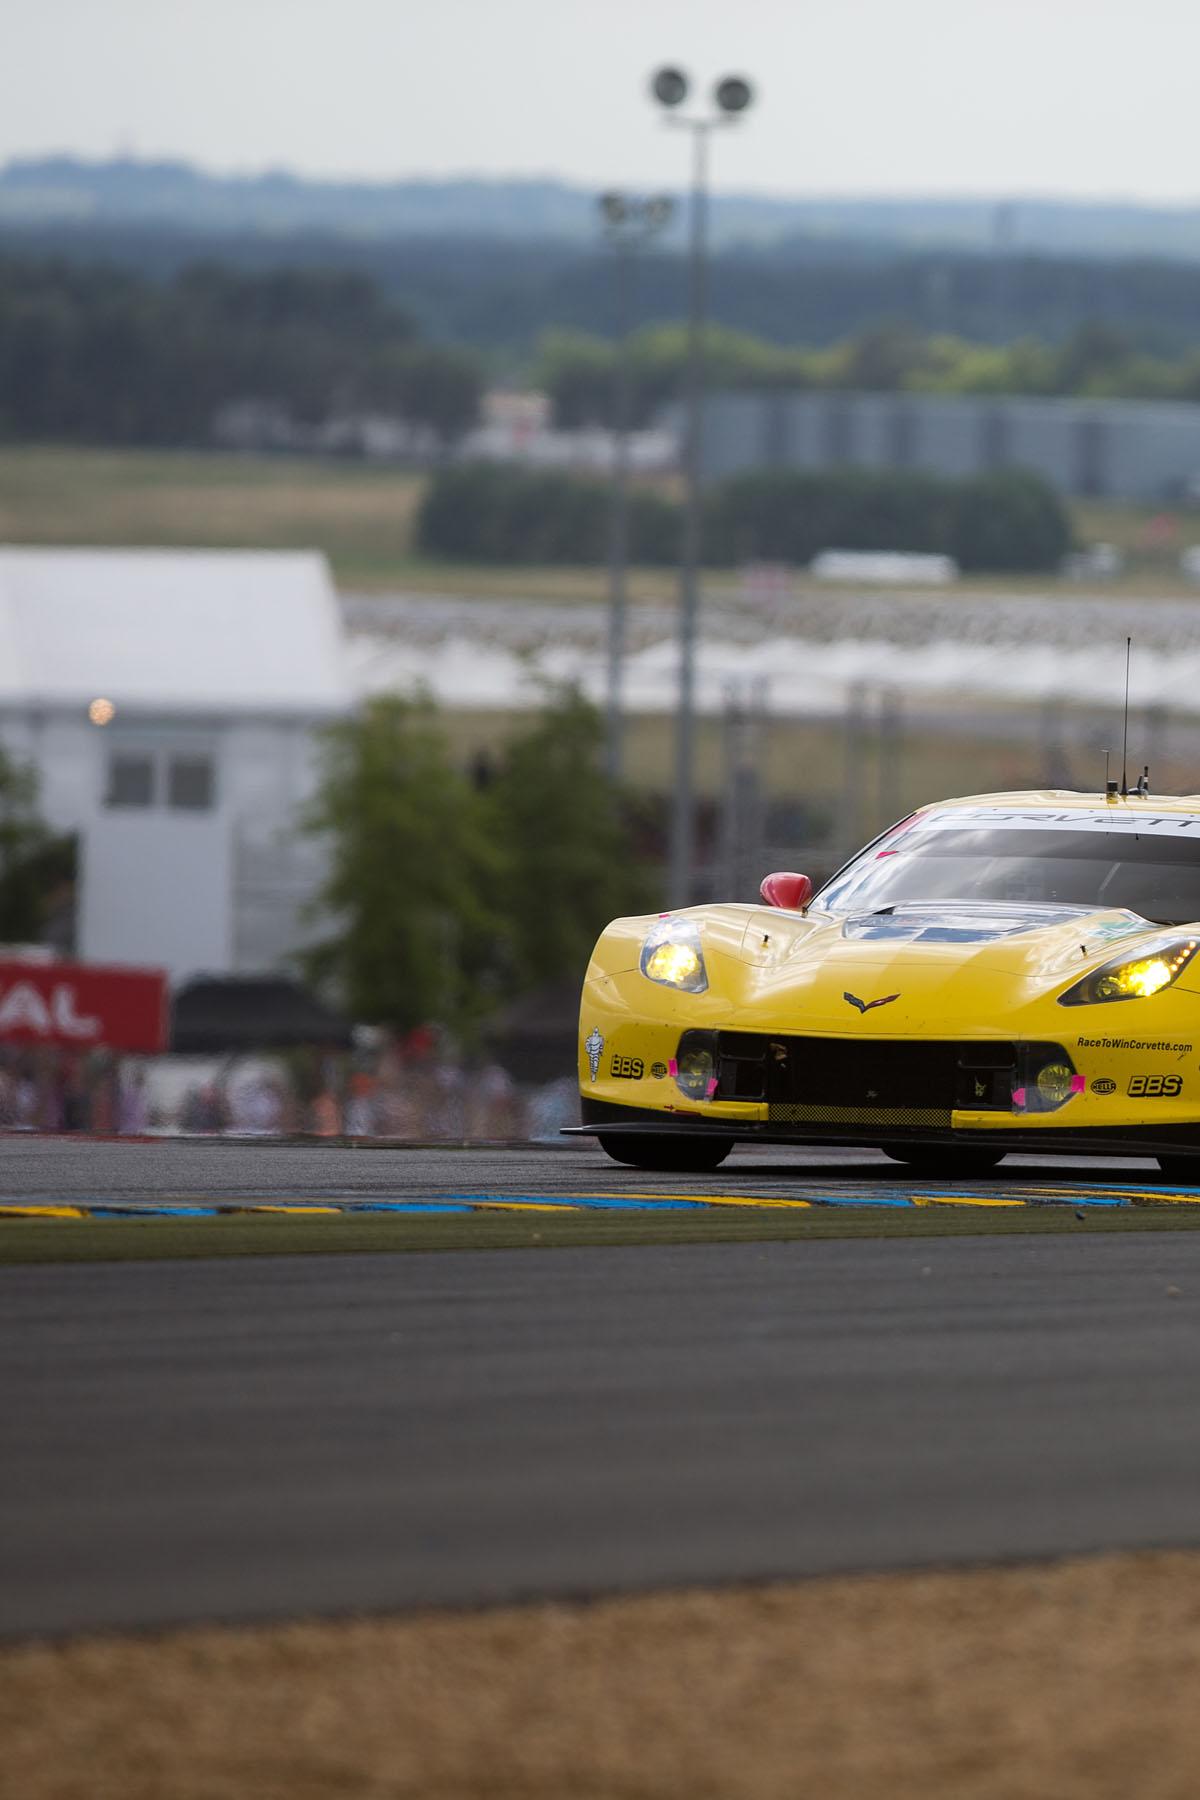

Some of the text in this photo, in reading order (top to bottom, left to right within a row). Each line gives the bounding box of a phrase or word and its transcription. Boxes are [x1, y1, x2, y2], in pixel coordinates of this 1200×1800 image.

[1077, 1036, 1193, 1053] RaceToWinCorvette.com
[611, 1055, 644, 1080] BBS
[1127, 1074, 1183, 1098] BBS
